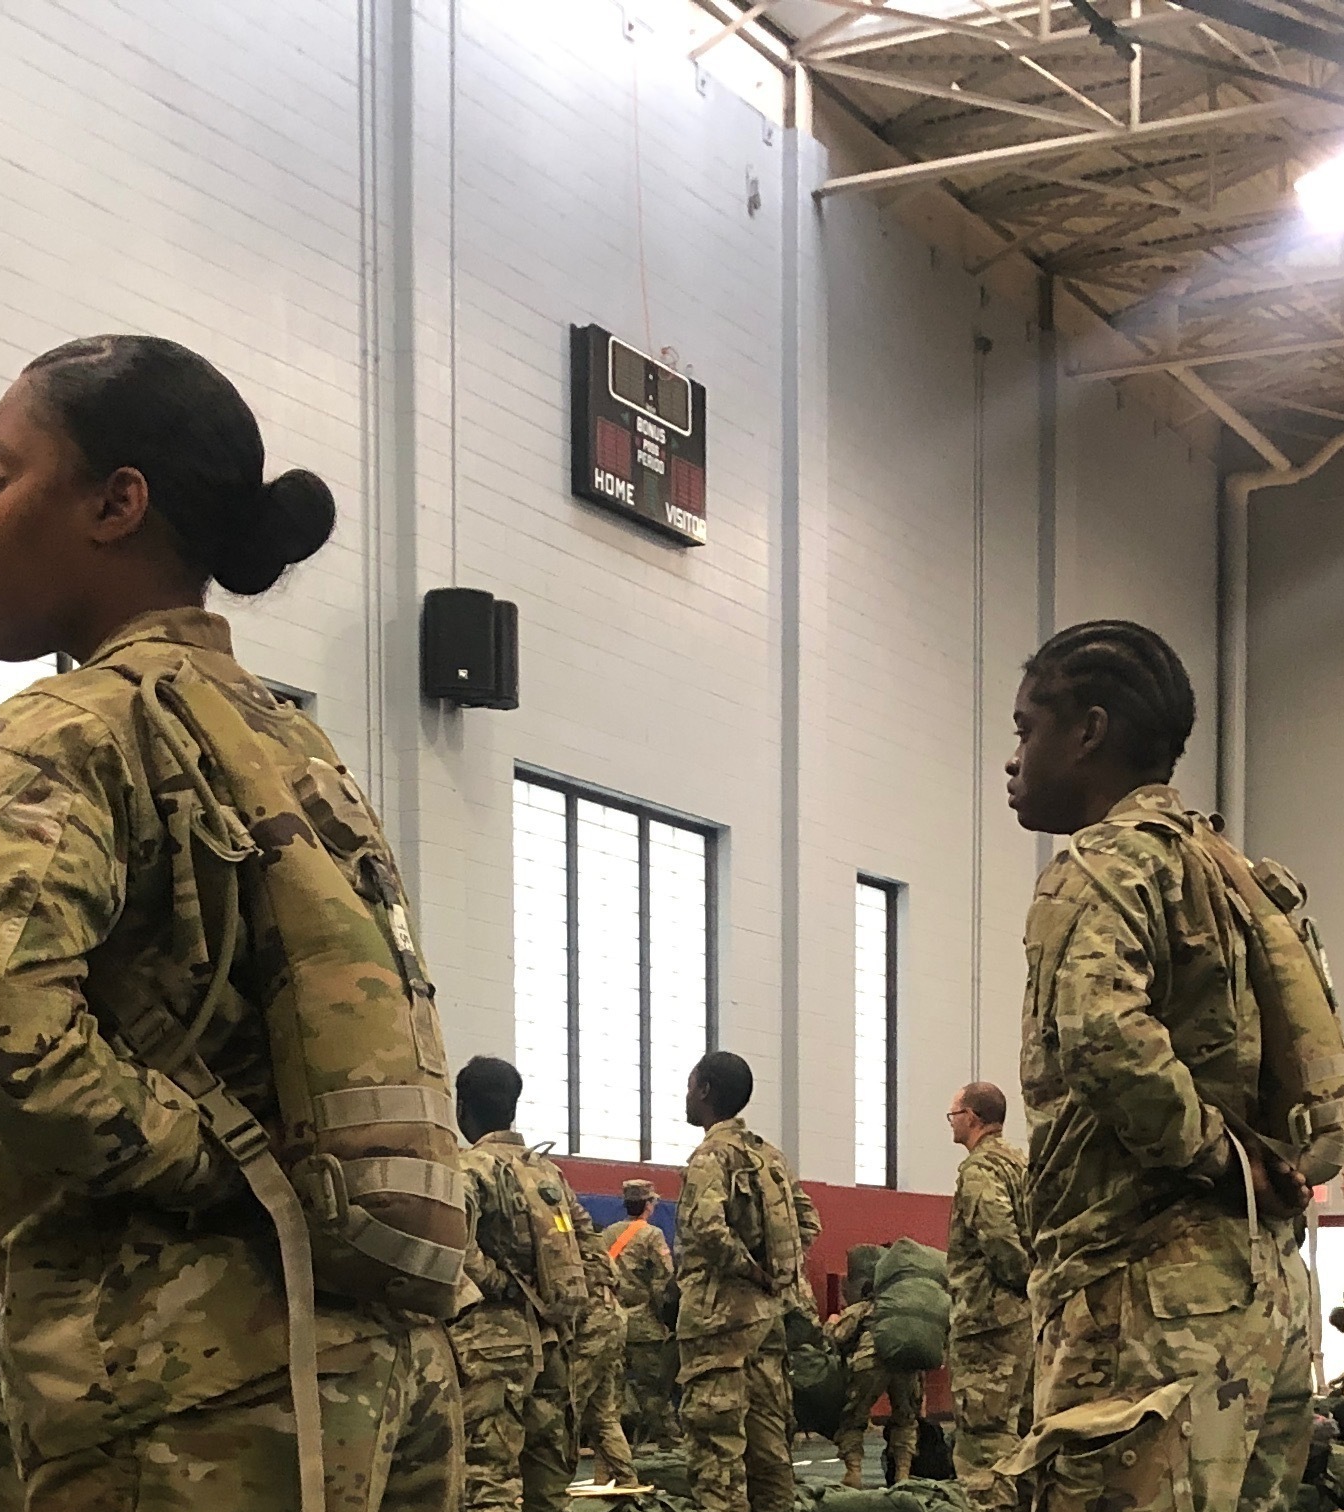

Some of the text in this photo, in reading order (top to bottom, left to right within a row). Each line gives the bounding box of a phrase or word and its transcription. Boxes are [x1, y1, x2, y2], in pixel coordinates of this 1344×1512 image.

[637, 416, 666, 444] BONUS
[637, 449, 665, 475] PERIOD
[594, 467, 635, 506] HOME
[665, 501, 706, 541] VISITOR
